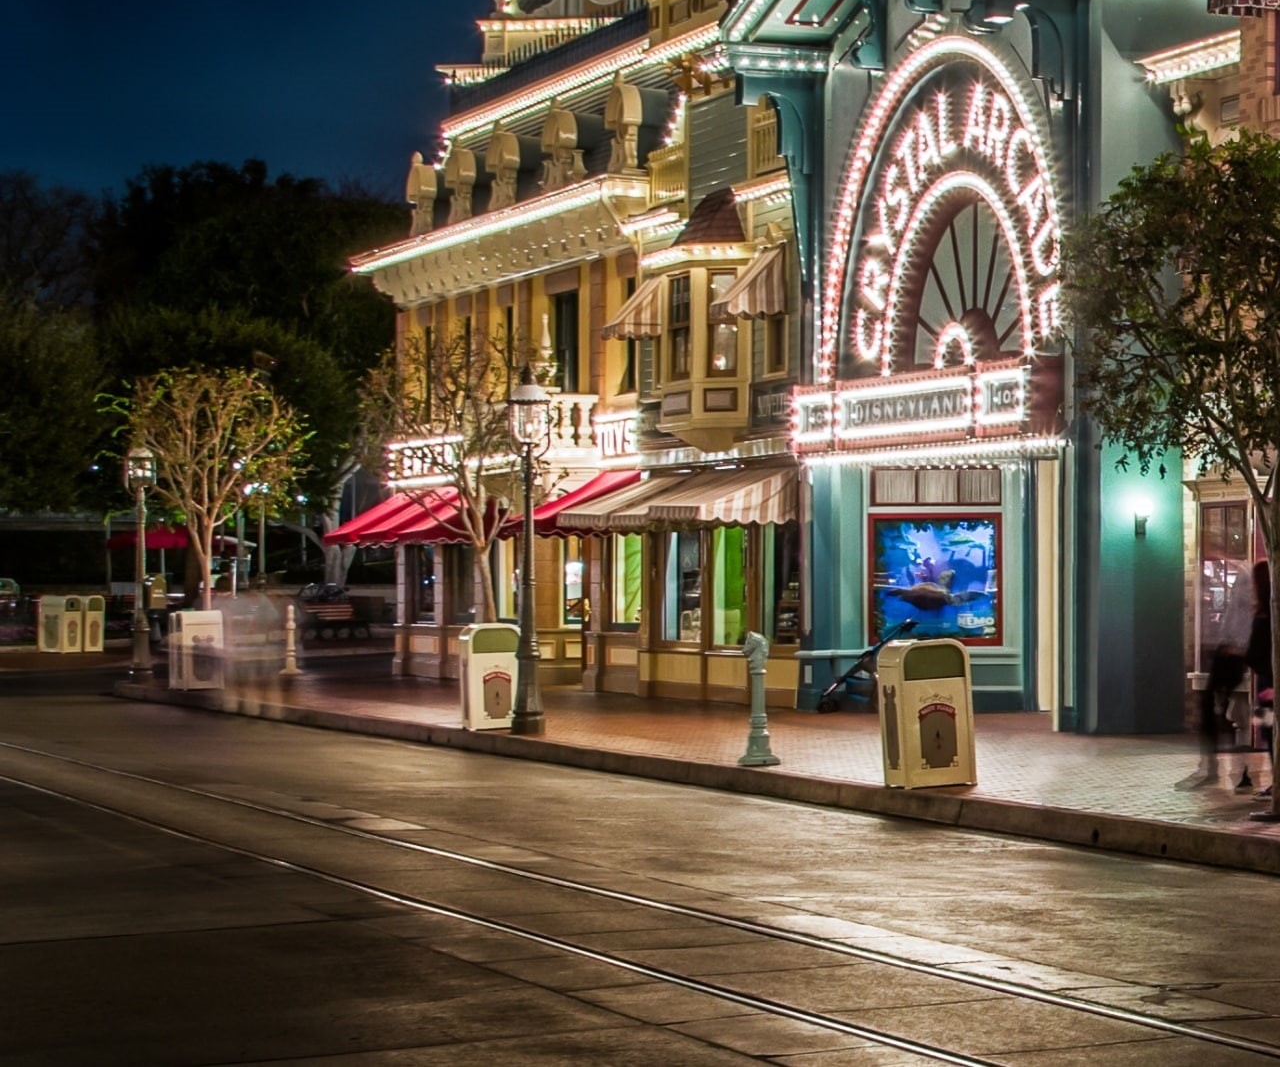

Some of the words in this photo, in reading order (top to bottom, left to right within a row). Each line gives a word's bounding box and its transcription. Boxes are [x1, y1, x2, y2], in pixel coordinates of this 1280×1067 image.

[853, 90, 957, 361] CRYSTAL
[962, 82, 1064, 338] ARCADE
[853, 392, 966, 424] DISNEYLAND
